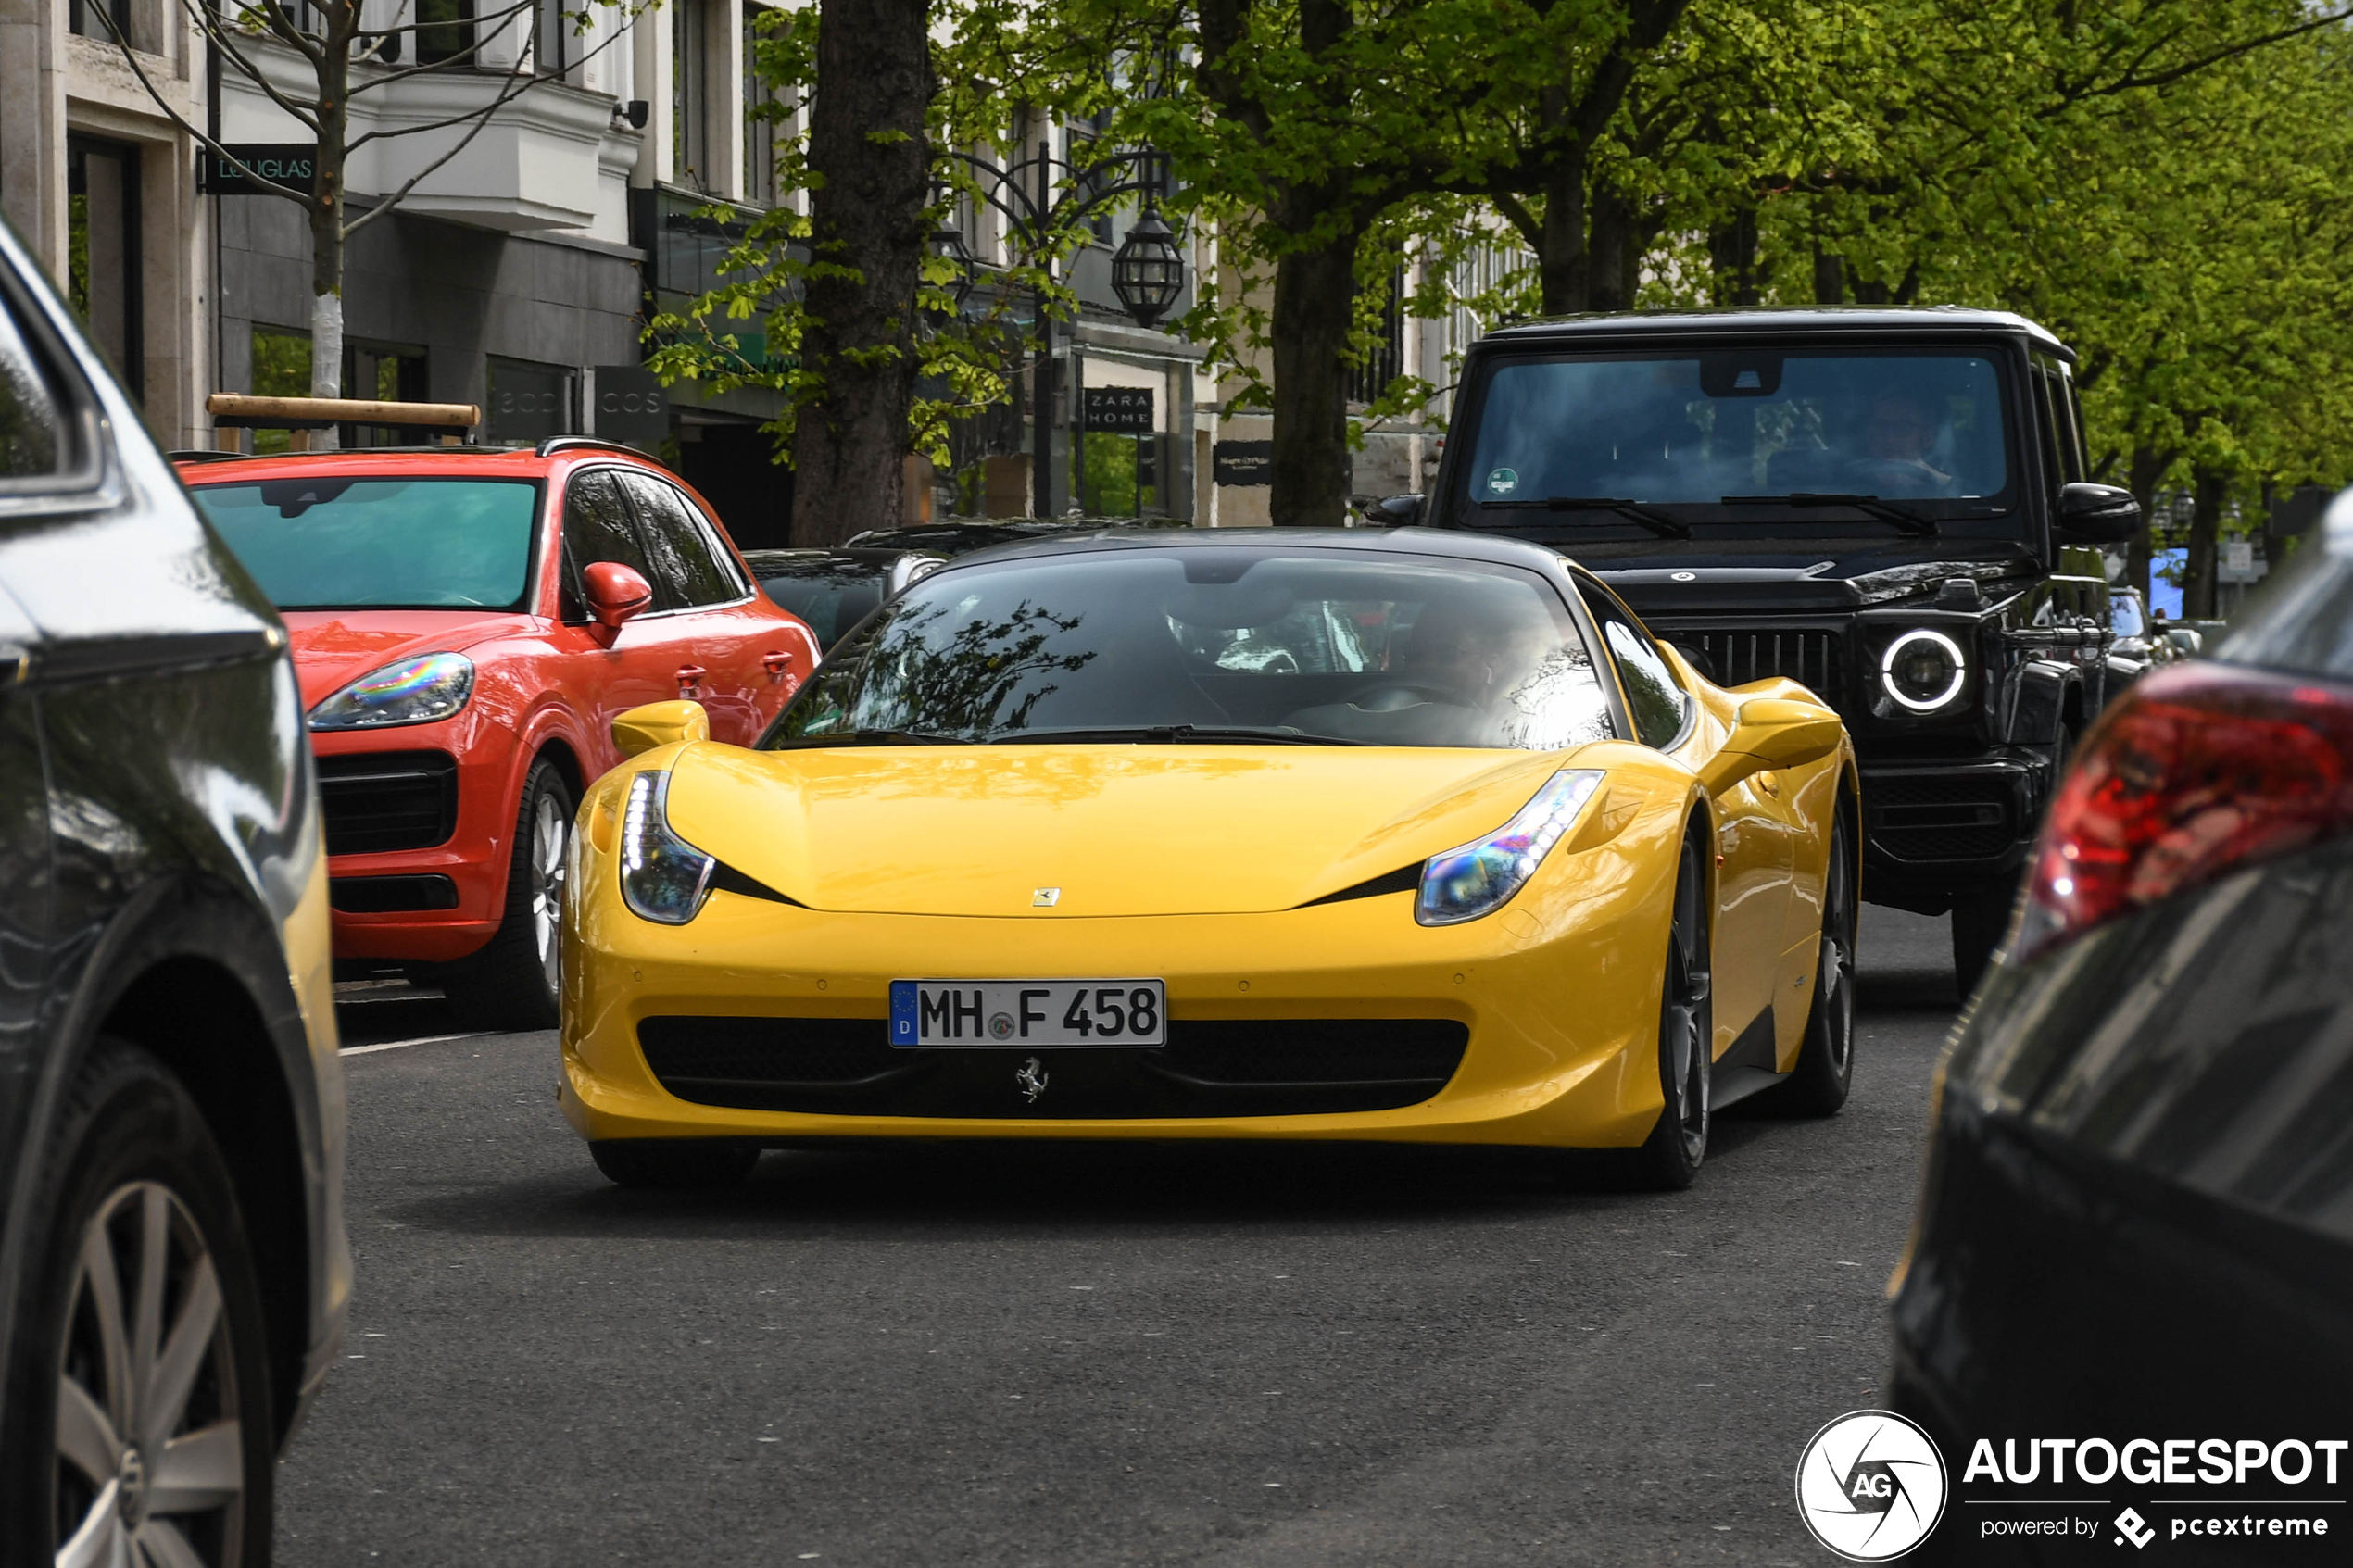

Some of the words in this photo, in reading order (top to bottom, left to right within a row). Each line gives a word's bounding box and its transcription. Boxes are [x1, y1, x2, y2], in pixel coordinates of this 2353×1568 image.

[602, 392, 661, 414] COS
[1091, 395, 1148, 407] ZARA
[1089, 413, 1149, 423] HOME
[920, 988, 984, 1038] MH
[1020, 988, 1051, 1037] F
[1063, 987, 1158, 1036] 458
[900, 1021, 911, 1035] D
